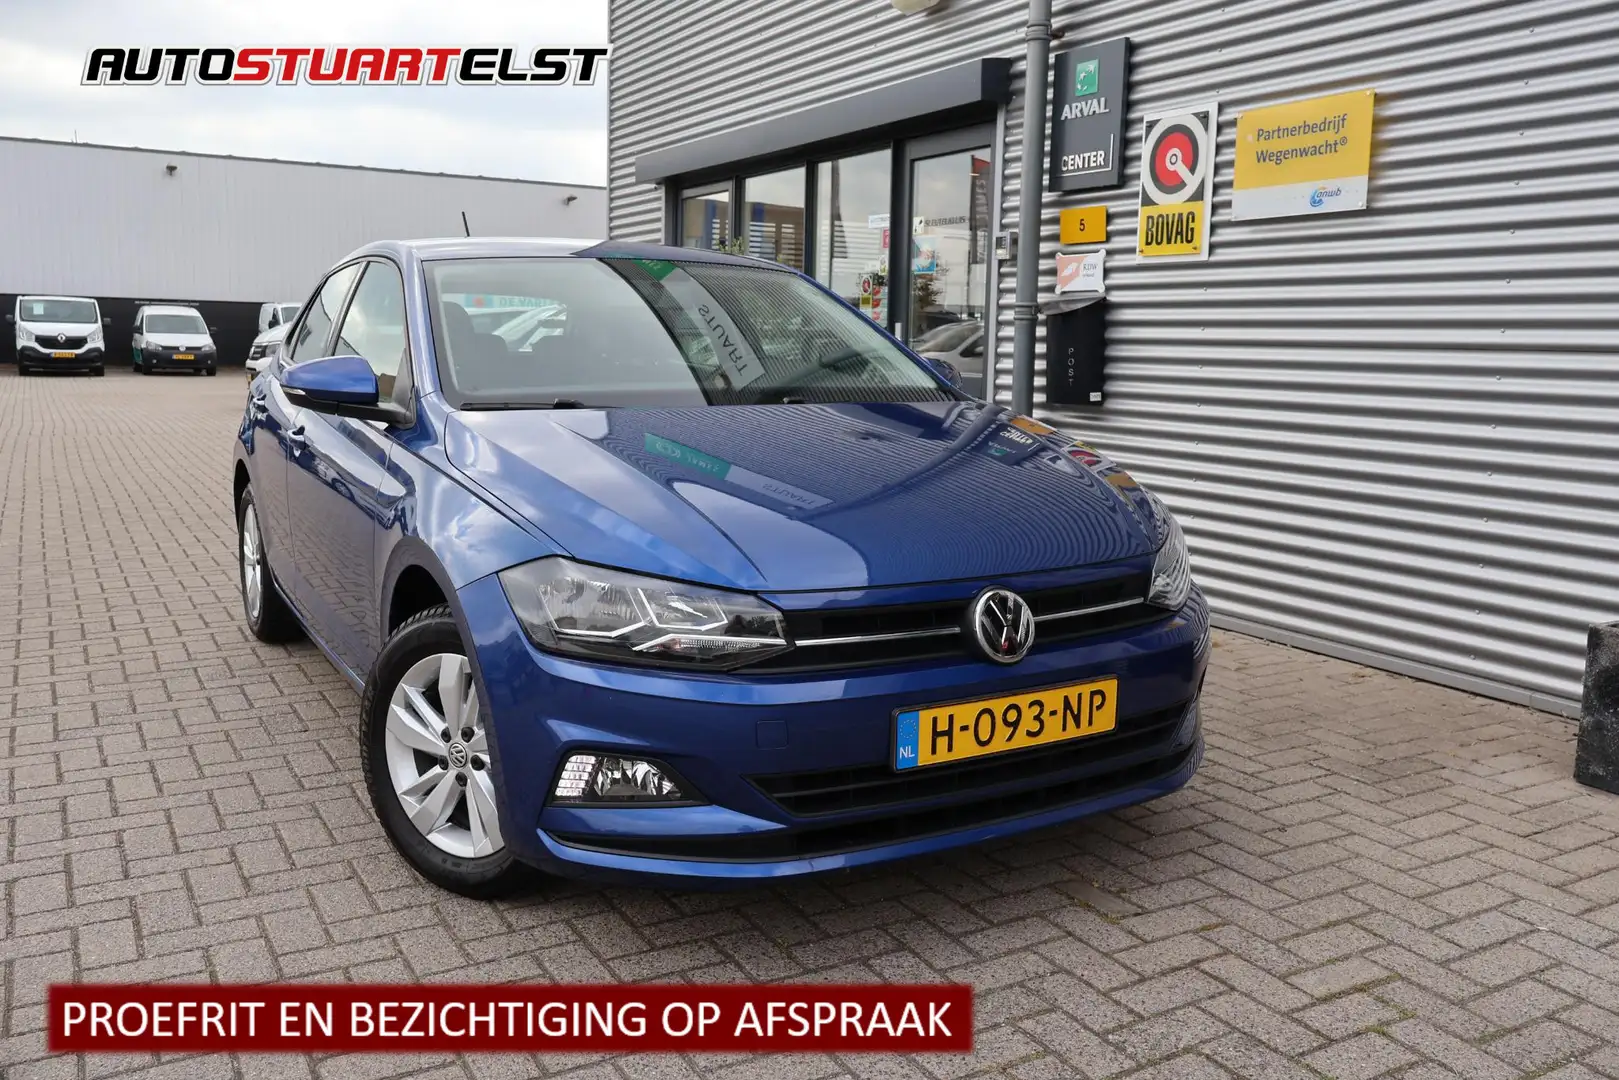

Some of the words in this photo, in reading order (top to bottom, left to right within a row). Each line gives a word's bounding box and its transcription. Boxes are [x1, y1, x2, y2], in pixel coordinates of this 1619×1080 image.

[1061, 97, 1110, 121] ARVAL
[1256, 113, 1348, 142] Partnerbedrijf
[1061, 150, 1105, 171] CENTER
[1316, 187, 1342, 198] anwb
[1079, 218, 1086, 232] 5
[1145, 211, 1196, 246] BOVAG
[900, 746, 916, 760] NL
[930, 689, 1107, 756] H-093-NP
